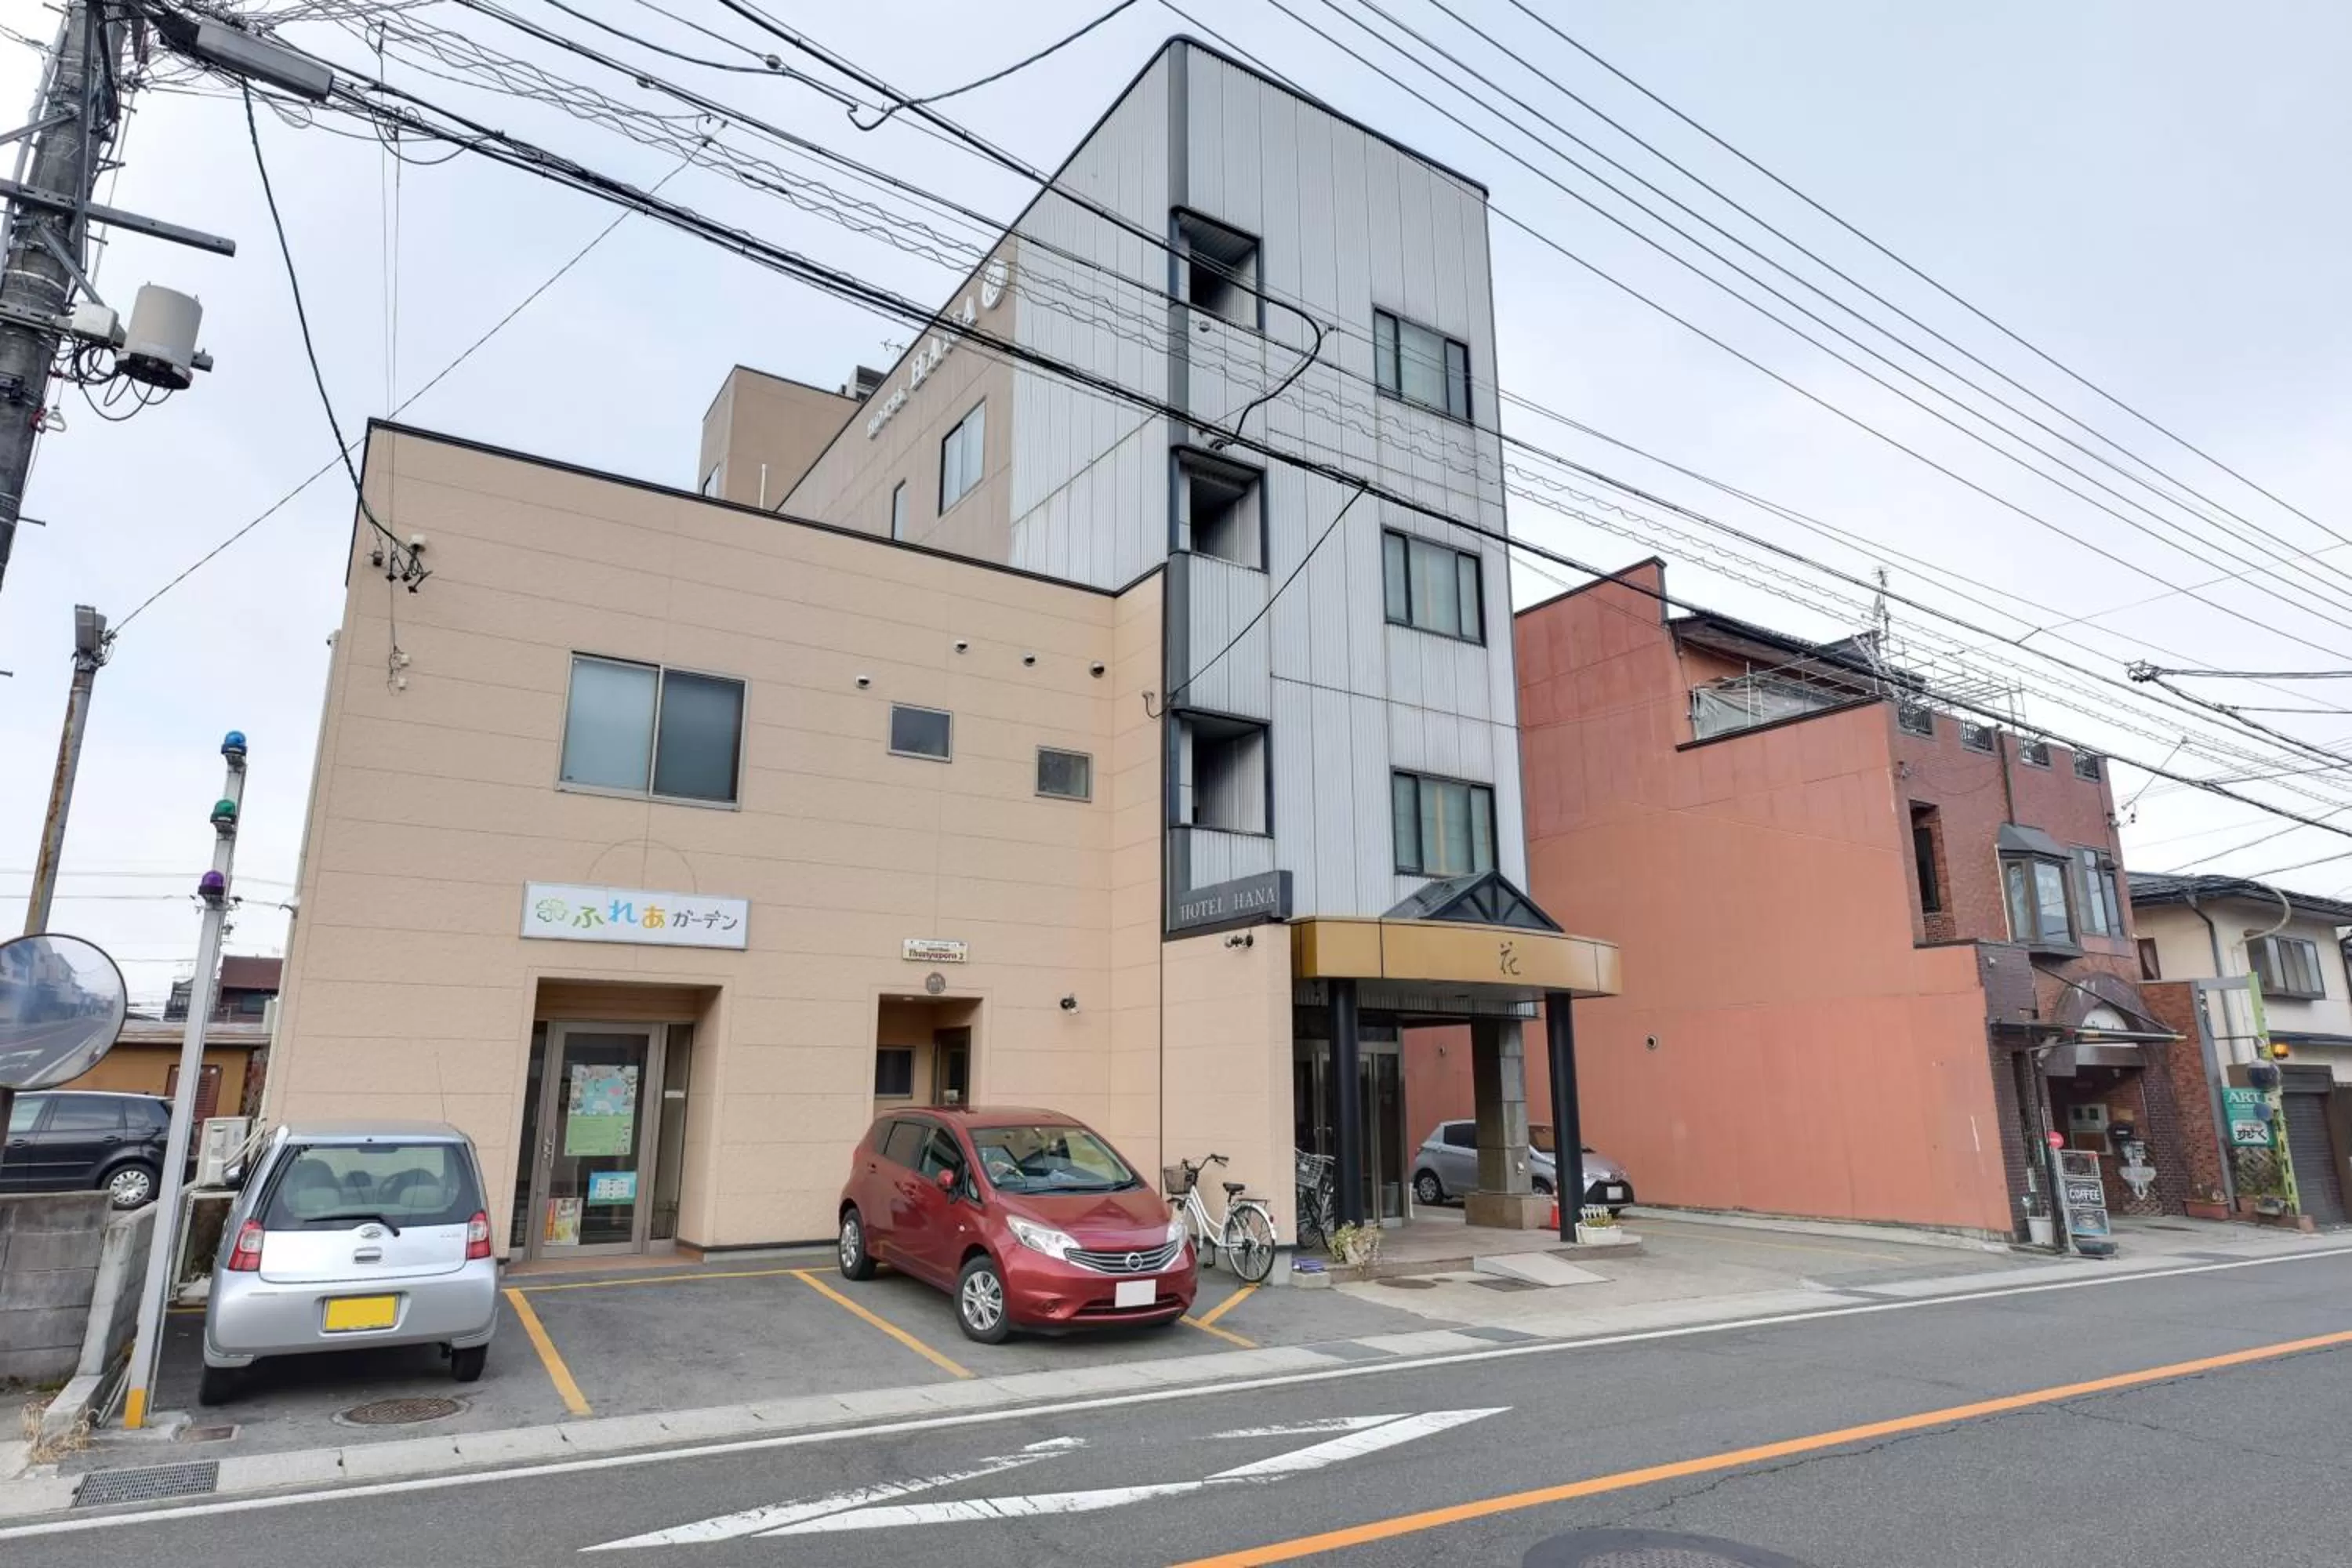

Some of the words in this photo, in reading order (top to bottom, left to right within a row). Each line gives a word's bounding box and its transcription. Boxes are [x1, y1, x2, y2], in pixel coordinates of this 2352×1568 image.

[572, 898, 739, 931] ふれあガーデン
[1180, 897, 1223, 922] HOTEL
[1234, 887, 1276, 910] HANA
[1500, 940, 1522, 976] 花
[2227, 1091, 2260, 1103] ART
[2068, 1188, 2101, 1201] COFFEE
